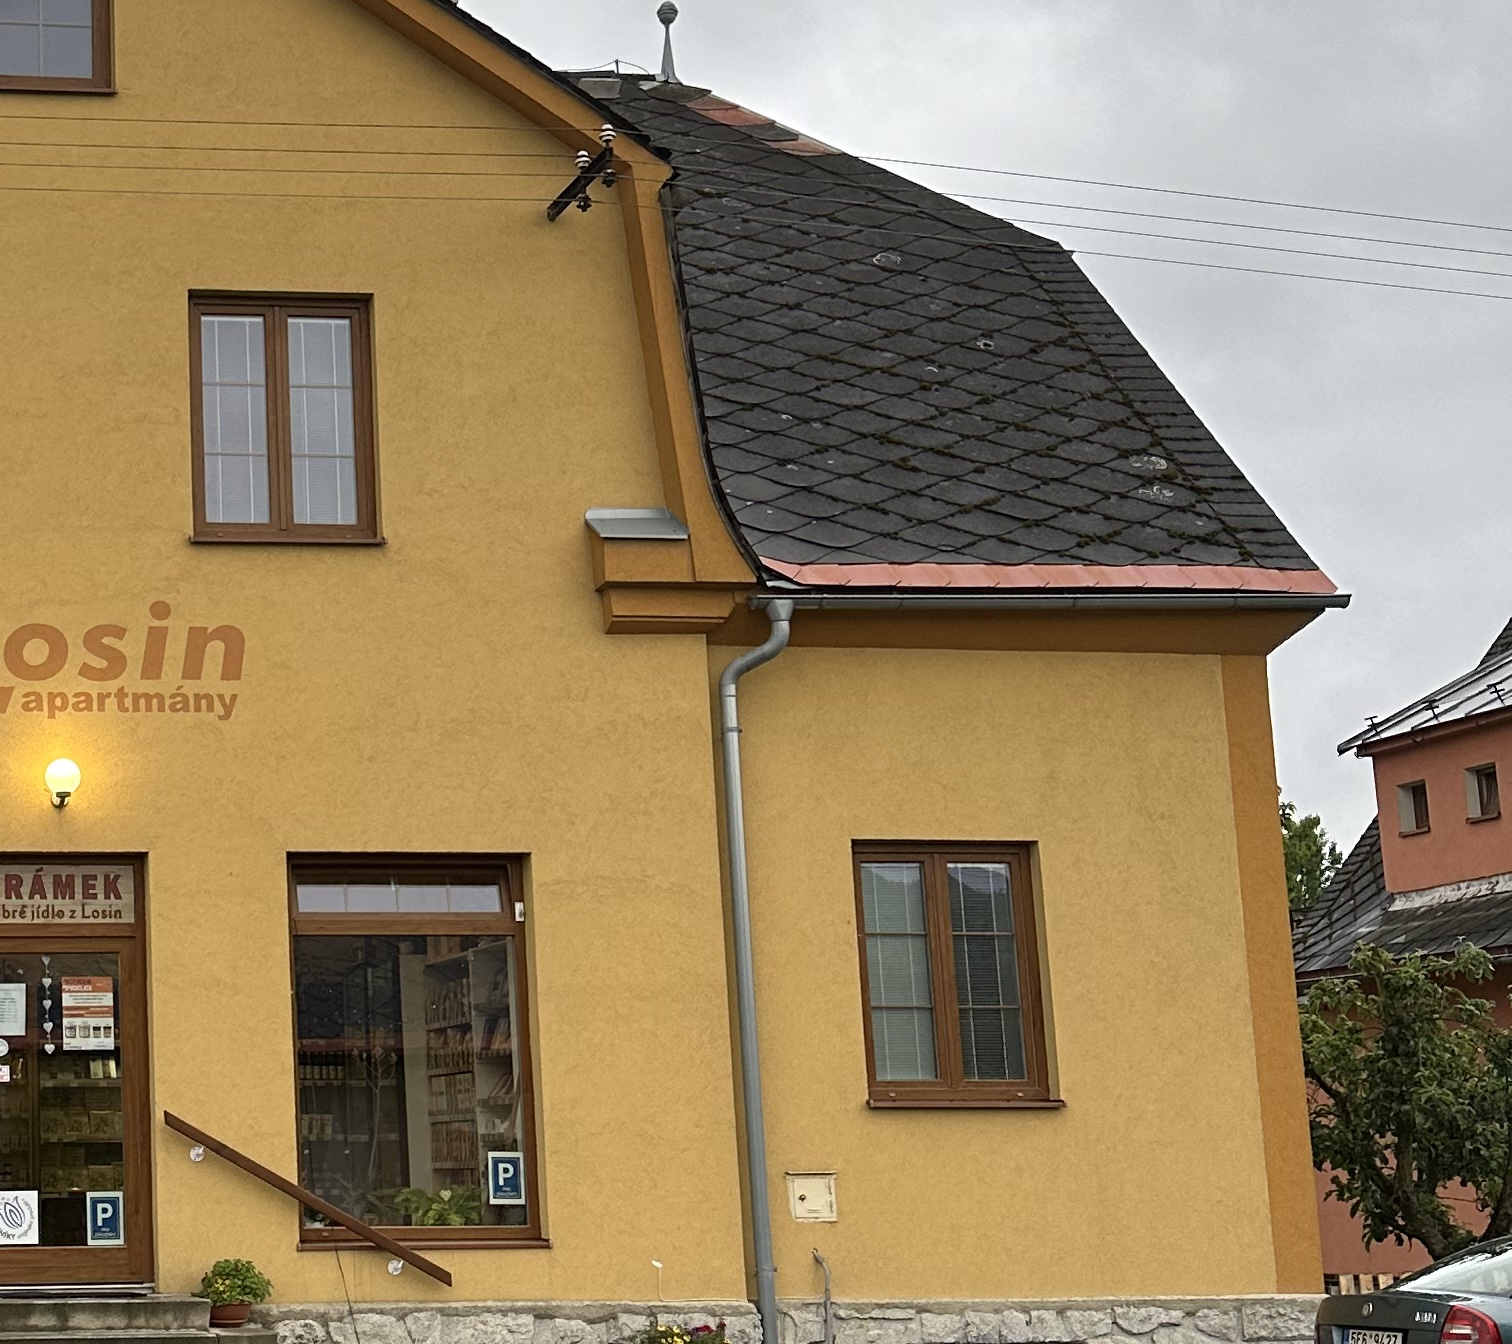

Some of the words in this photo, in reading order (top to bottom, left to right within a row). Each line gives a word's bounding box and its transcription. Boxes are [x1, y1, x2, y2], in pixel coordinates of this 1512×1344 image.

[21, 685, 238, 720] apartmány
[31, 903, 65, 922] jídlo
[69, 909, 77, 919] z
[81, 903, 123, 919] Losin
[498, 1162, 514, 1186] P
[96, 1202, 113, 1226] P
